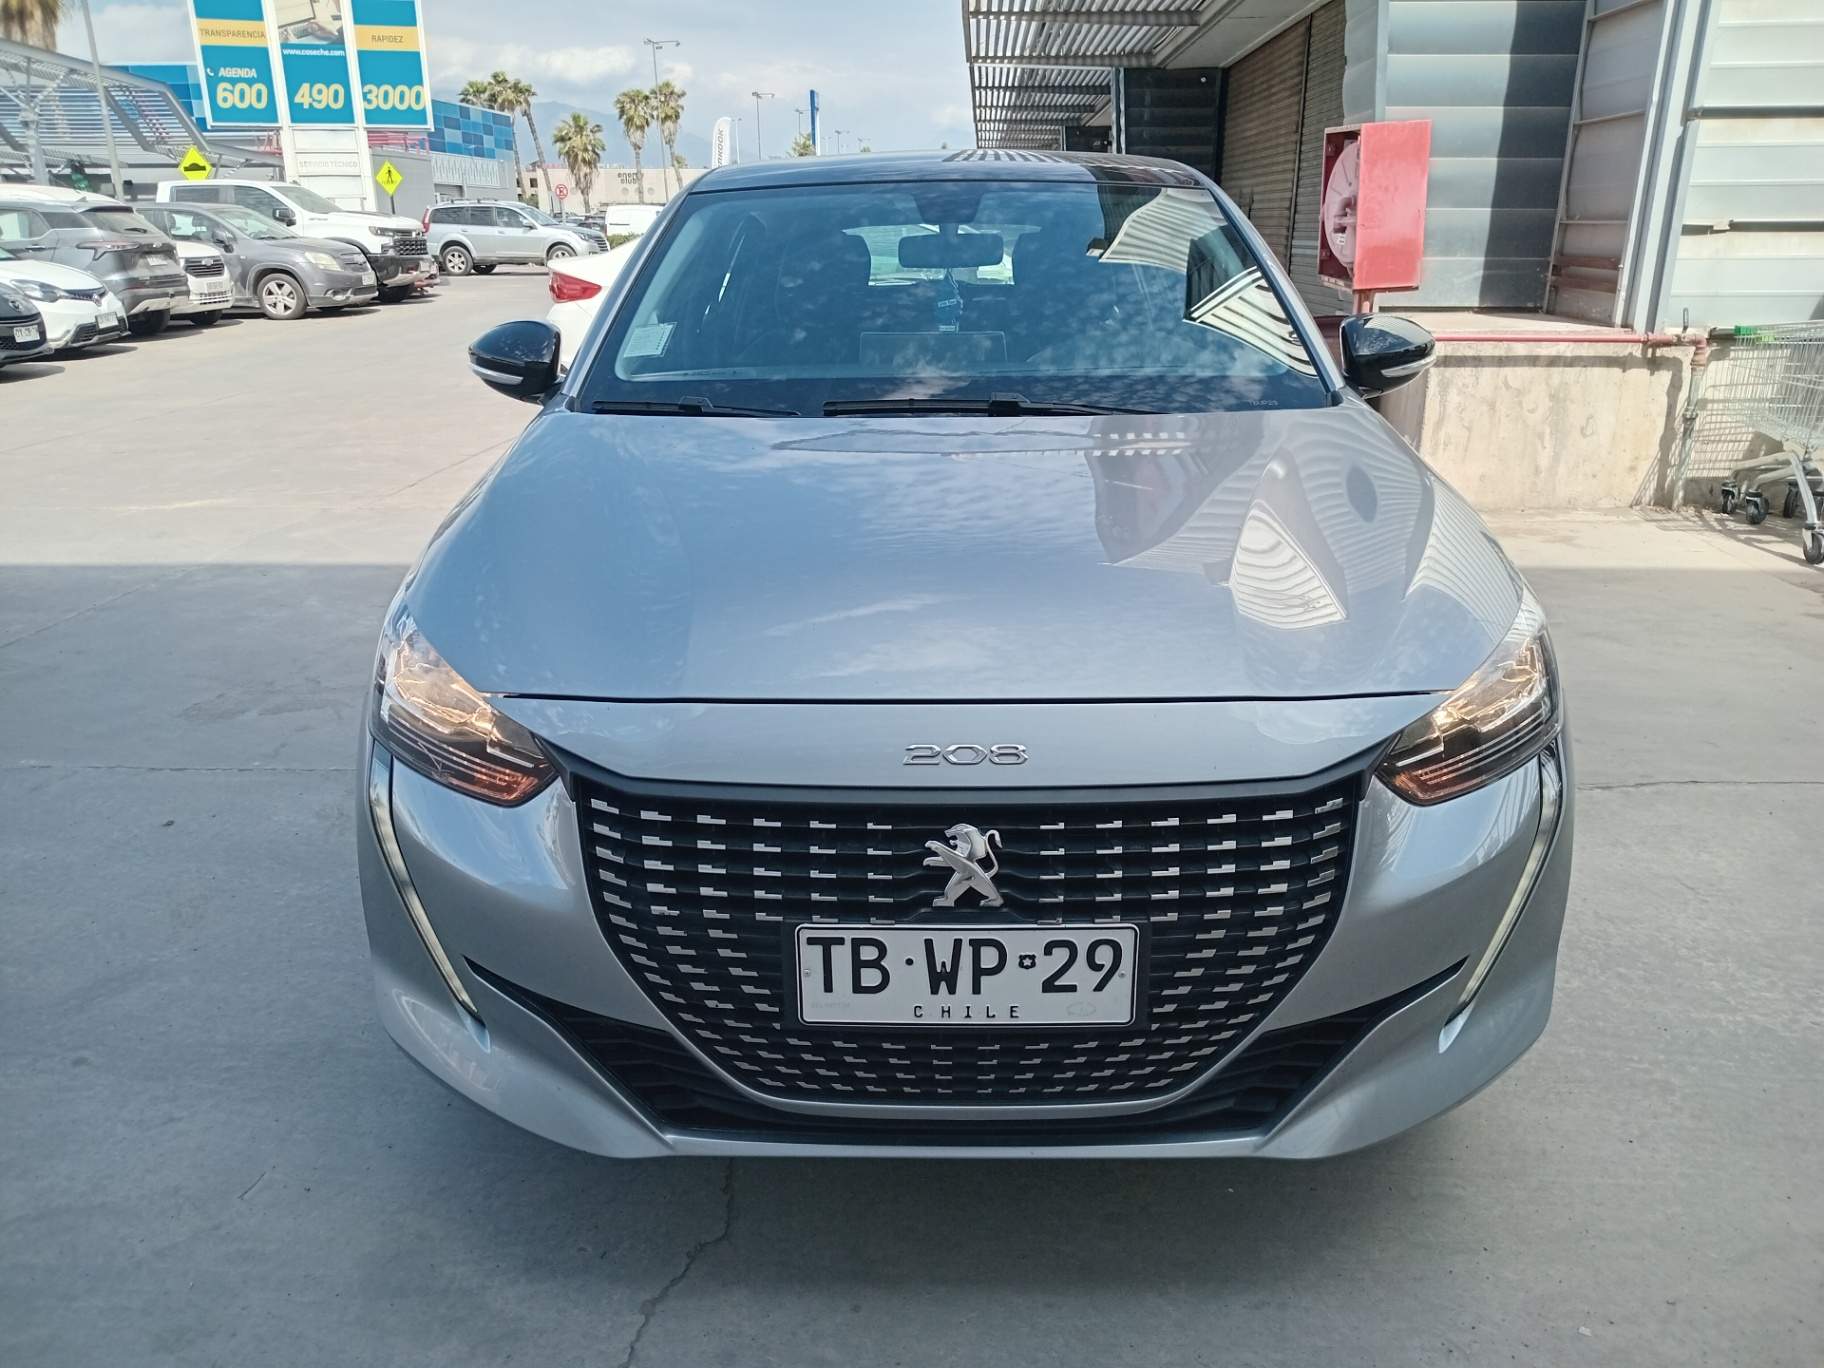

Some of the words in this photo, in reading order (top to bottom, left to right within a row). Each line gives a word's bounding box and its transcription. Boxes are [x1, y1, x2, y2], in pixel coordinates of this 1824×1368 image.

[200, 28, 266, 39] TRANSPARENCIA
[371, 34, 404, 44] RAPIDEZ
[218, 67, 257, 79] AGENDA
[216, 82, 268, 109] 600
[294, 82, 345, 109] 490
[362, 84, 426, 110] 3000
[903, 744, 1029, 766] 208
[913, 1005, 1020, 1020] CHILE
